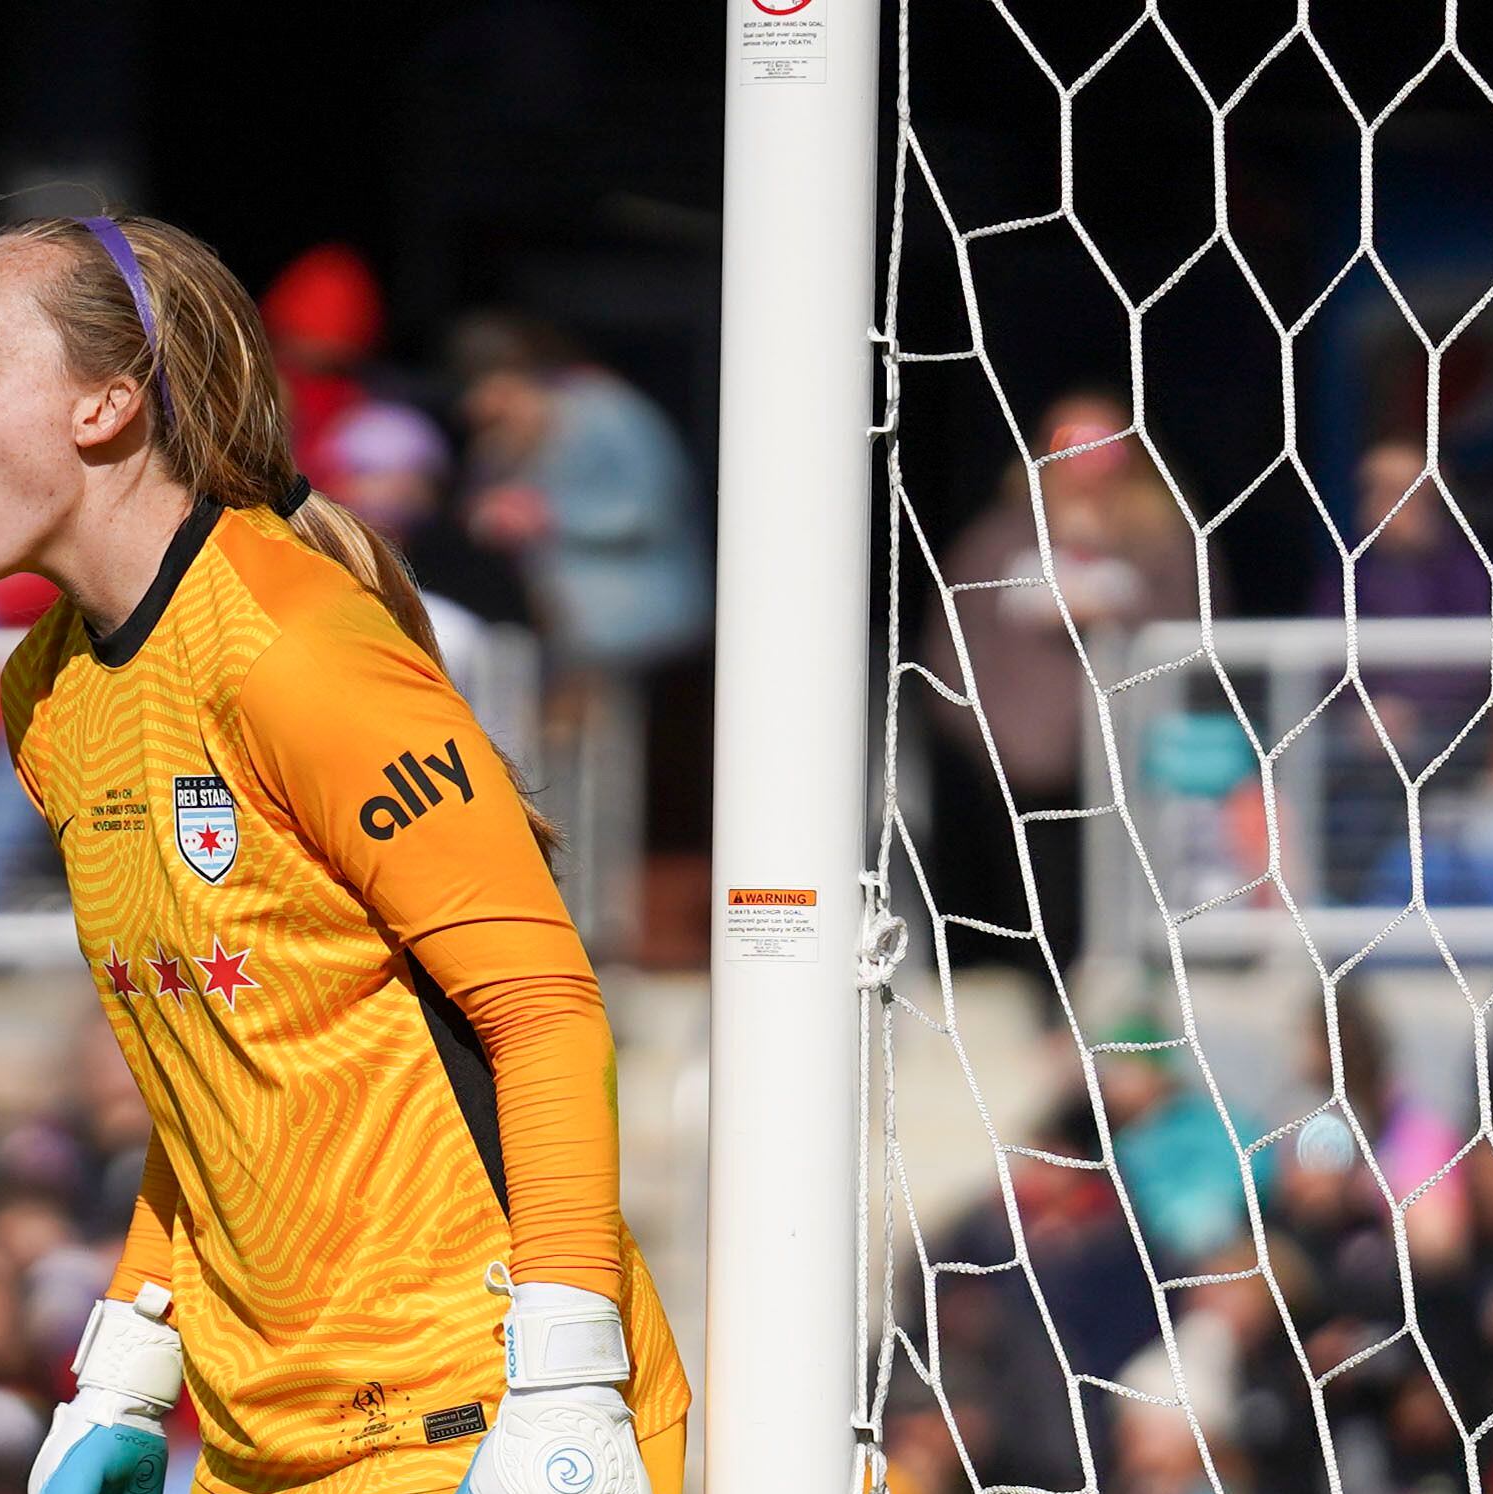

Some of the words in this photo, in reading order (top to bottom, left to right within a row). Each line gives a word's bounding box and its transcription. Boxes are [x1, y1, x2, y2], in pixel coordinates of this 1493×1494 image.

[177, 779, 223, 787] CHICA
[359, 737, 475, 841] ally
[177, 788, 198, 807] RED
[200, 788, 233, 807] STARS
[124, 803, 147, 815] STADIUM
[92, 820, 122, 832] NOVEMBER
[745, 893, 807, 905] WARNING
[506, 1322, 517, 1379] KONA
